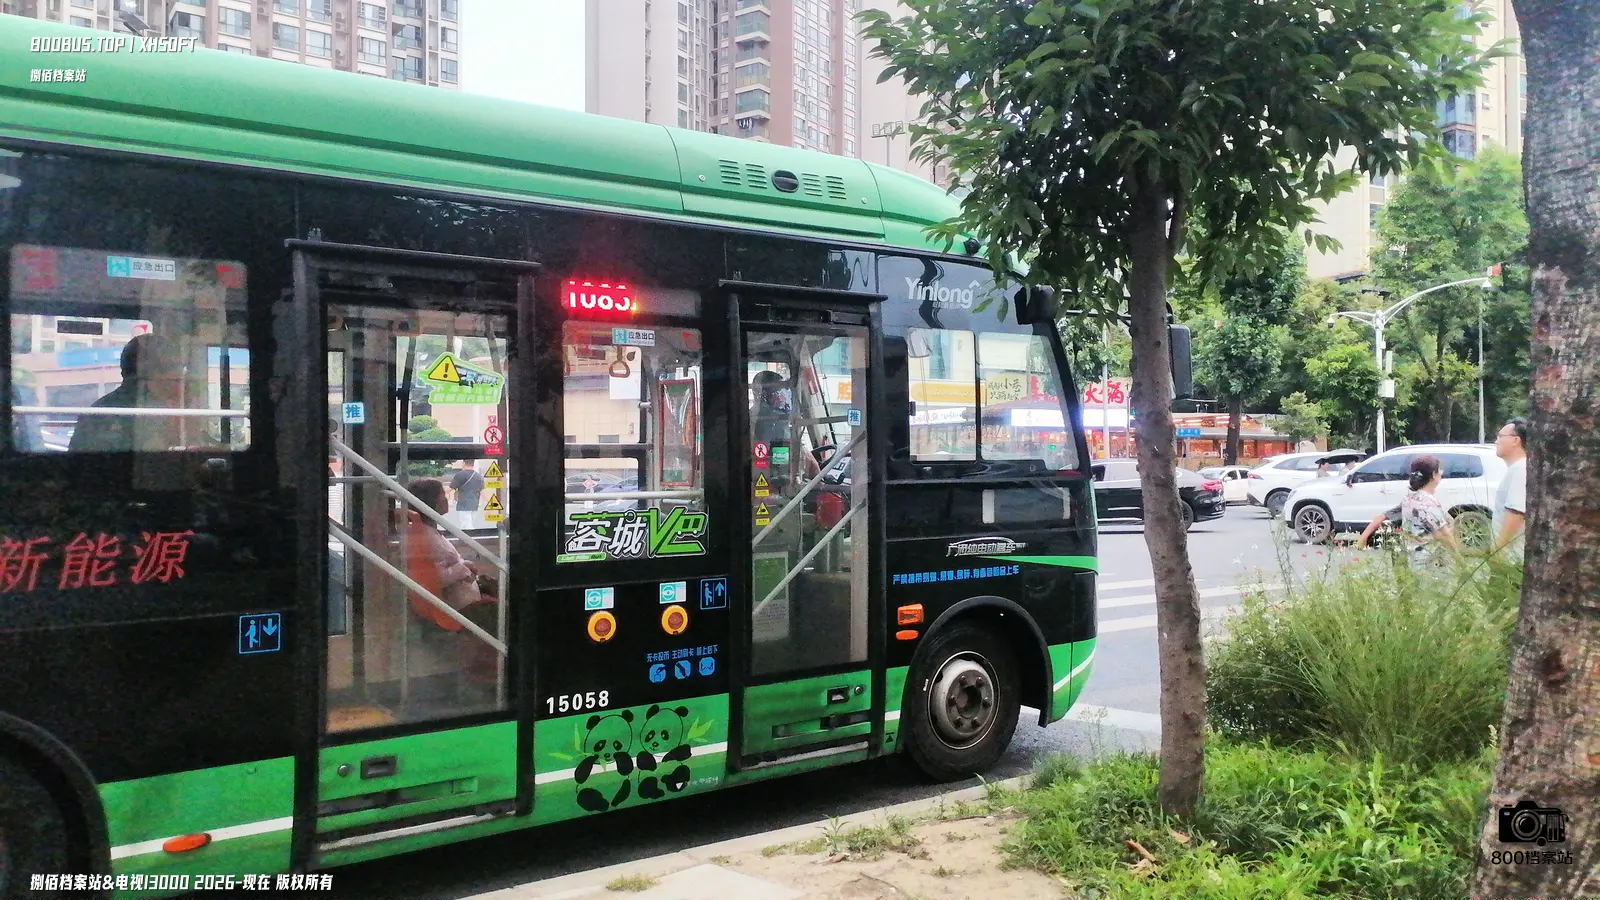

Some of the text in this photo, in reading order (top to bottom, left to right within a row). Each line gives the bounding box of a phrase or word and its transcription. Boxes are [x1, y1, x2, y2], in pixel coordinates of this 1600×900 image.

[132, 261, 174, 274] 应急出口
[904, 276, 974, 309] Yinlong
[628, 331, 655, 340] 应急出口
[1084, 380, 1125, 404] 火锅
[345, 404, 361, 418] 推
[849, 411, 859, 422] 推
[0, 529, 195, 592] 新能源
[546, 690, 610, 714] 15058
